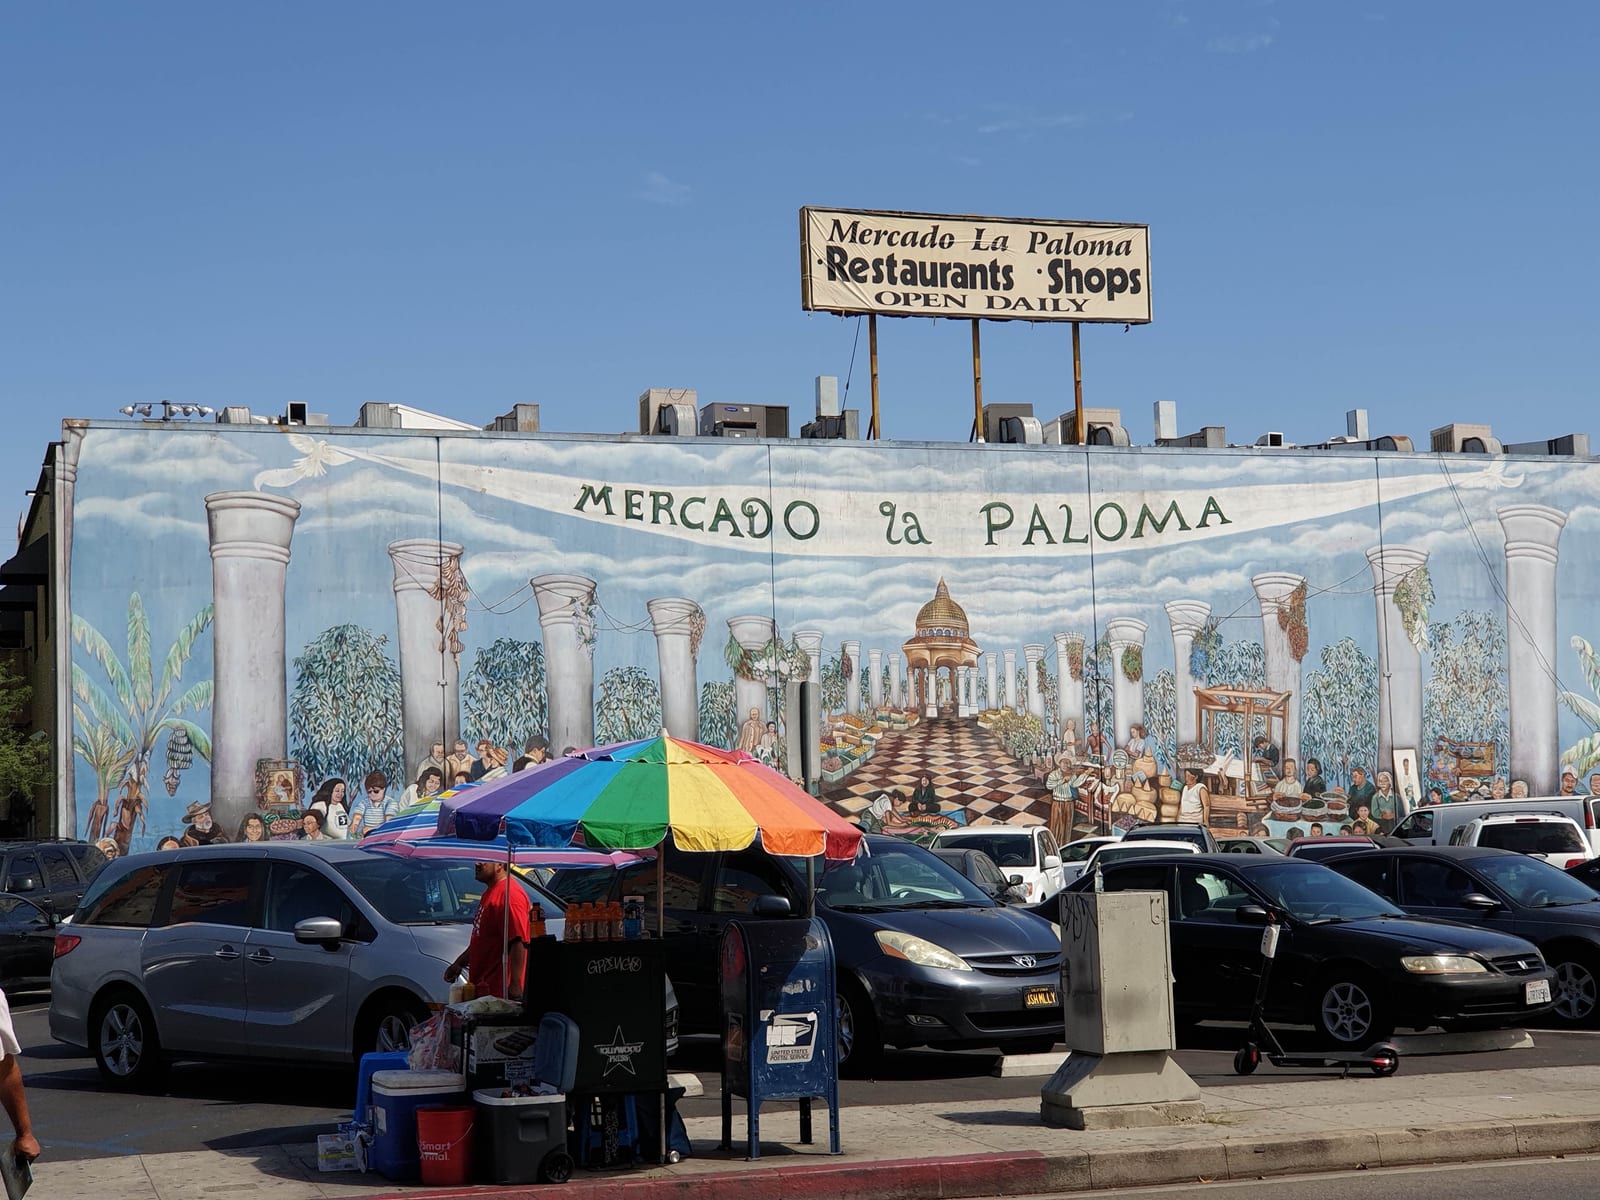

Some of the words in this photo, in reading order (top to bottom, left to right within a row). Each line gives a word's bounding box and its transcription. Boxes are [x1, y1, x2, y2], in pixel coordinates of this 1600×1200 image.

[829, 219, 955, 250] Mercado
[971, 228, 1009, 251] La
[1026, 230, 1132, 257] Paloma
[826, 245, 1014, 291] Restaurants
[1048, 258, 1141, 301] Shops
[874, 290, 968, 308] OPEN
[986, 295, 1090, 312] DAILY
[573, 484, 820, 540] MERCADO
[980, 496, 1232, 545] PALOMA
